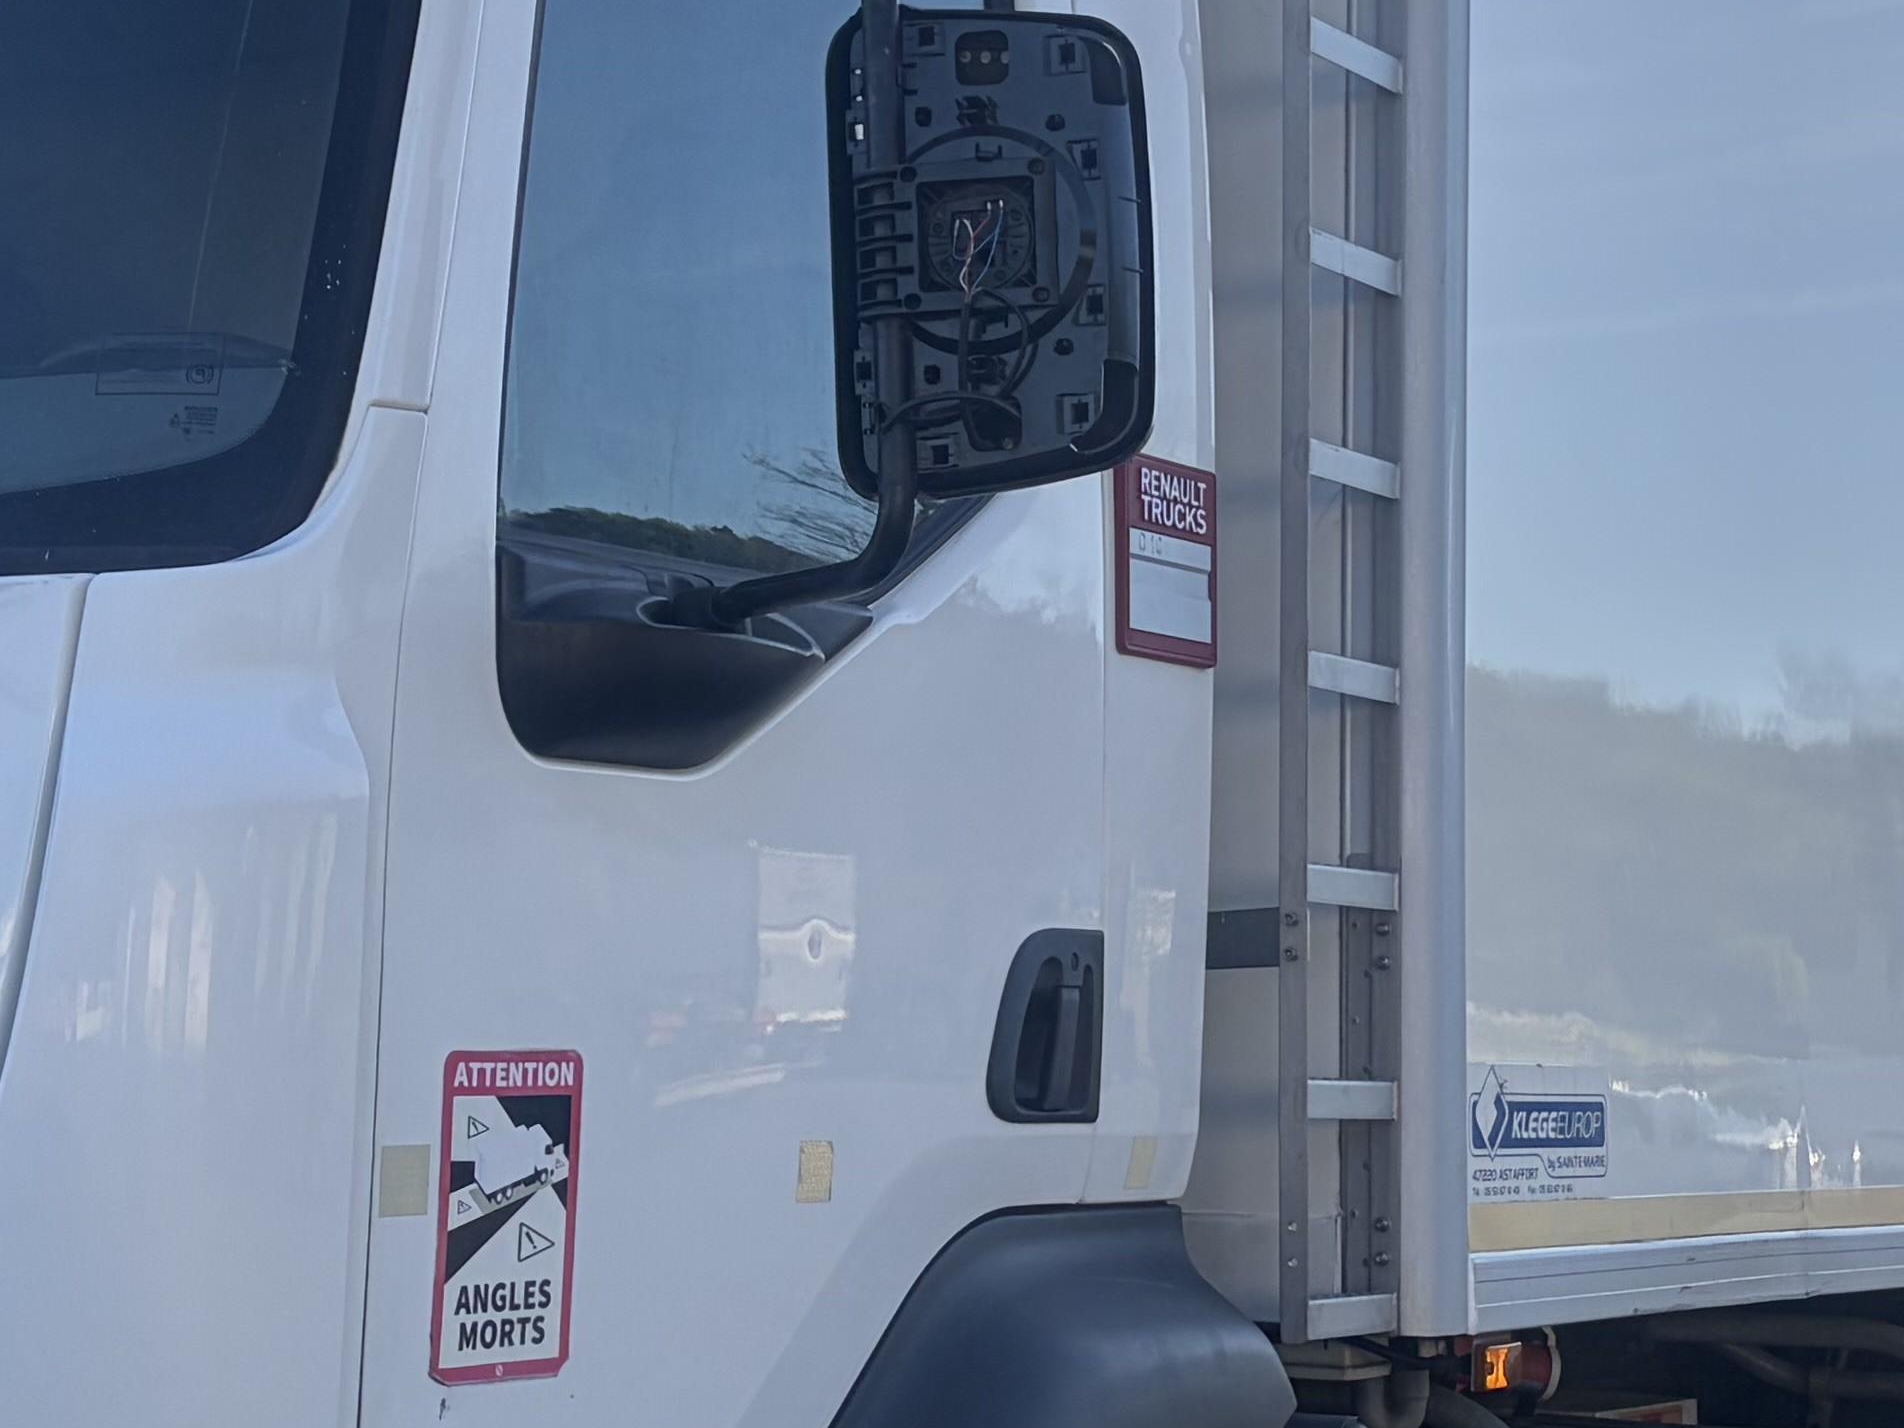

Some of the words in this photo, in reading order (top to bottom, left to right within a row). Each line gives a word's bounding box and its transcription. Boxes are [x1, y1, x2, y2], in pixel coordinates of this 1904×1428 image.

[1141, 467, 1207, 508] RENAULT
[1141, 494, 1207, 535] TRUCKS
[454, 1061, 575, 1088] ATTENTION
[1511, 1111, 1602, 1139] KLEGEEUROP
[454, 1278, 552, 1316] ANGLES
[457, 1315, 546, 1352] MORTS
